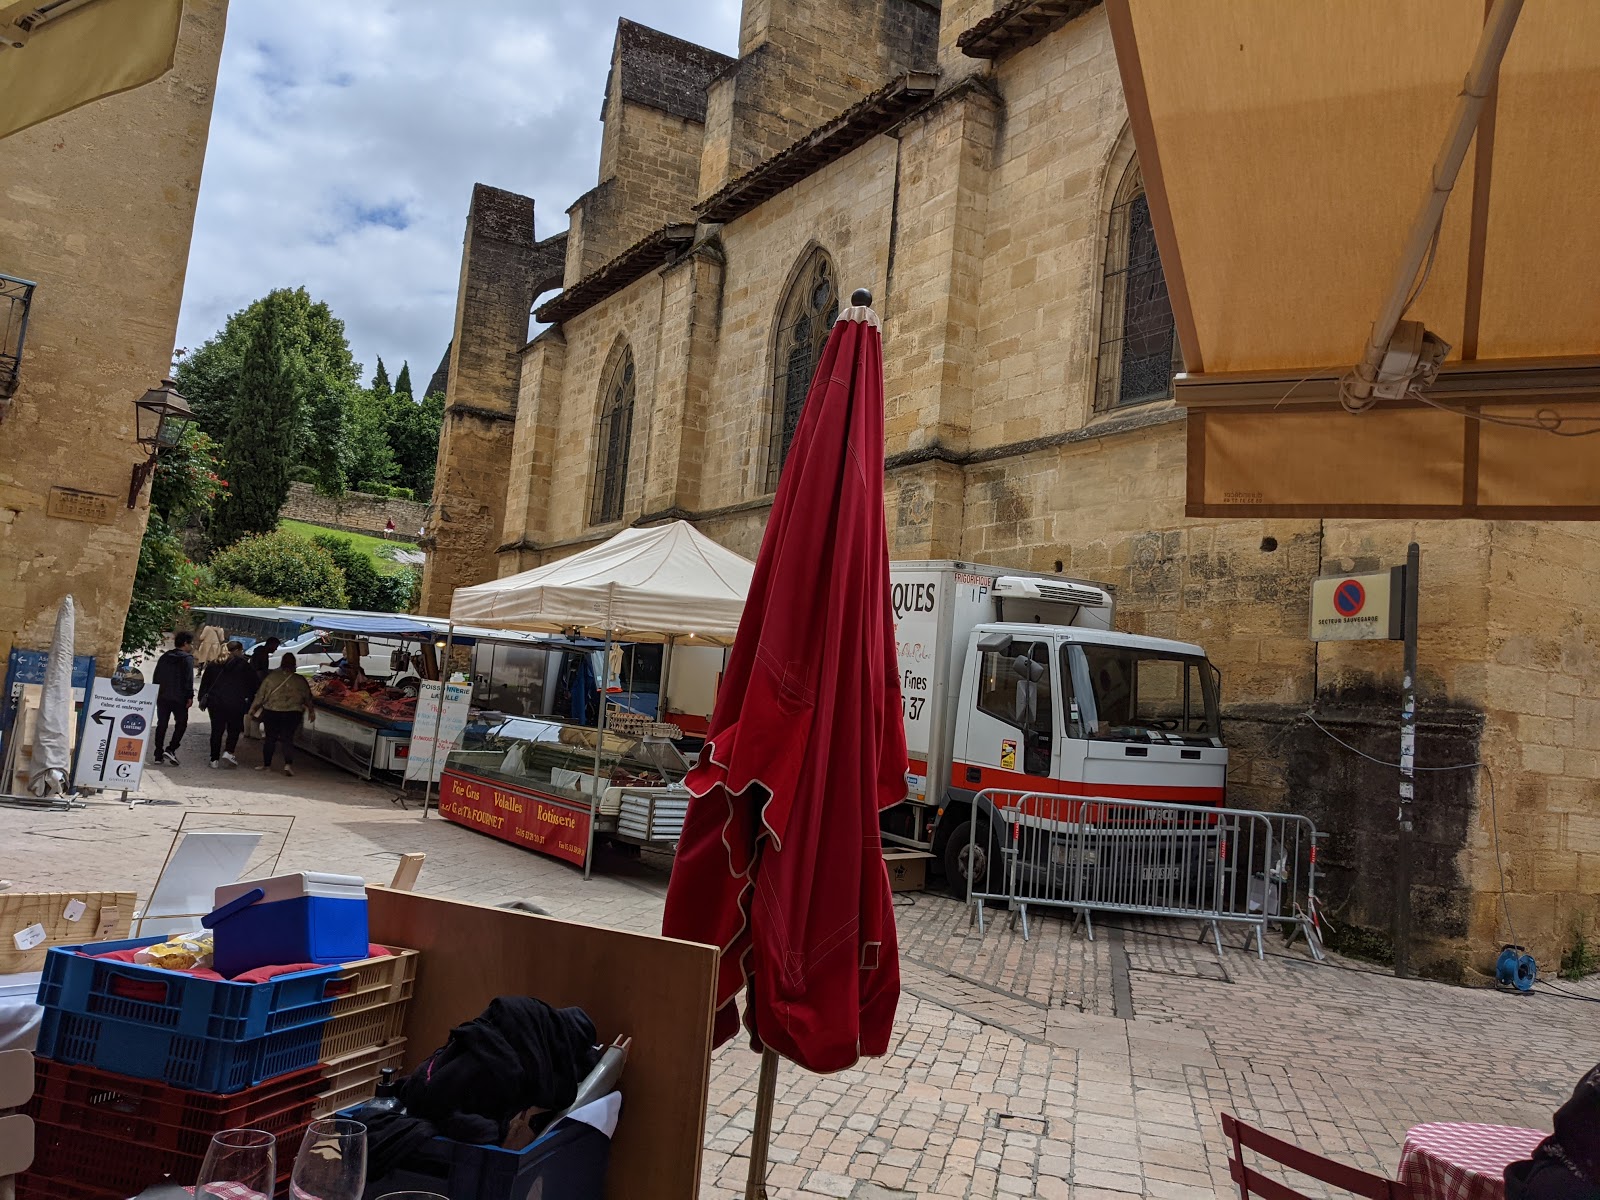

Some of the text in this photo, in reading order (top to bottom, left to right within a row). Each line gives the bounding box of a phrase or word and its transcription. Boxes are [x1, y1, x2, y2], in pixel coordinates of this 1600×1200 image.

[954, 572, 992, 587] FRIGORIFIQUE
[889, 582, 936, 620] QUES
[421, 683, 471, 695] POISSNNERIE
[904, 669, 928, 691] fines
[908, 696, 926, 721] 37
[452, 780, 464, 797] Foie
[466, 785, 480, 801] Gras
[472, 809, 505, 830] FOURNET
